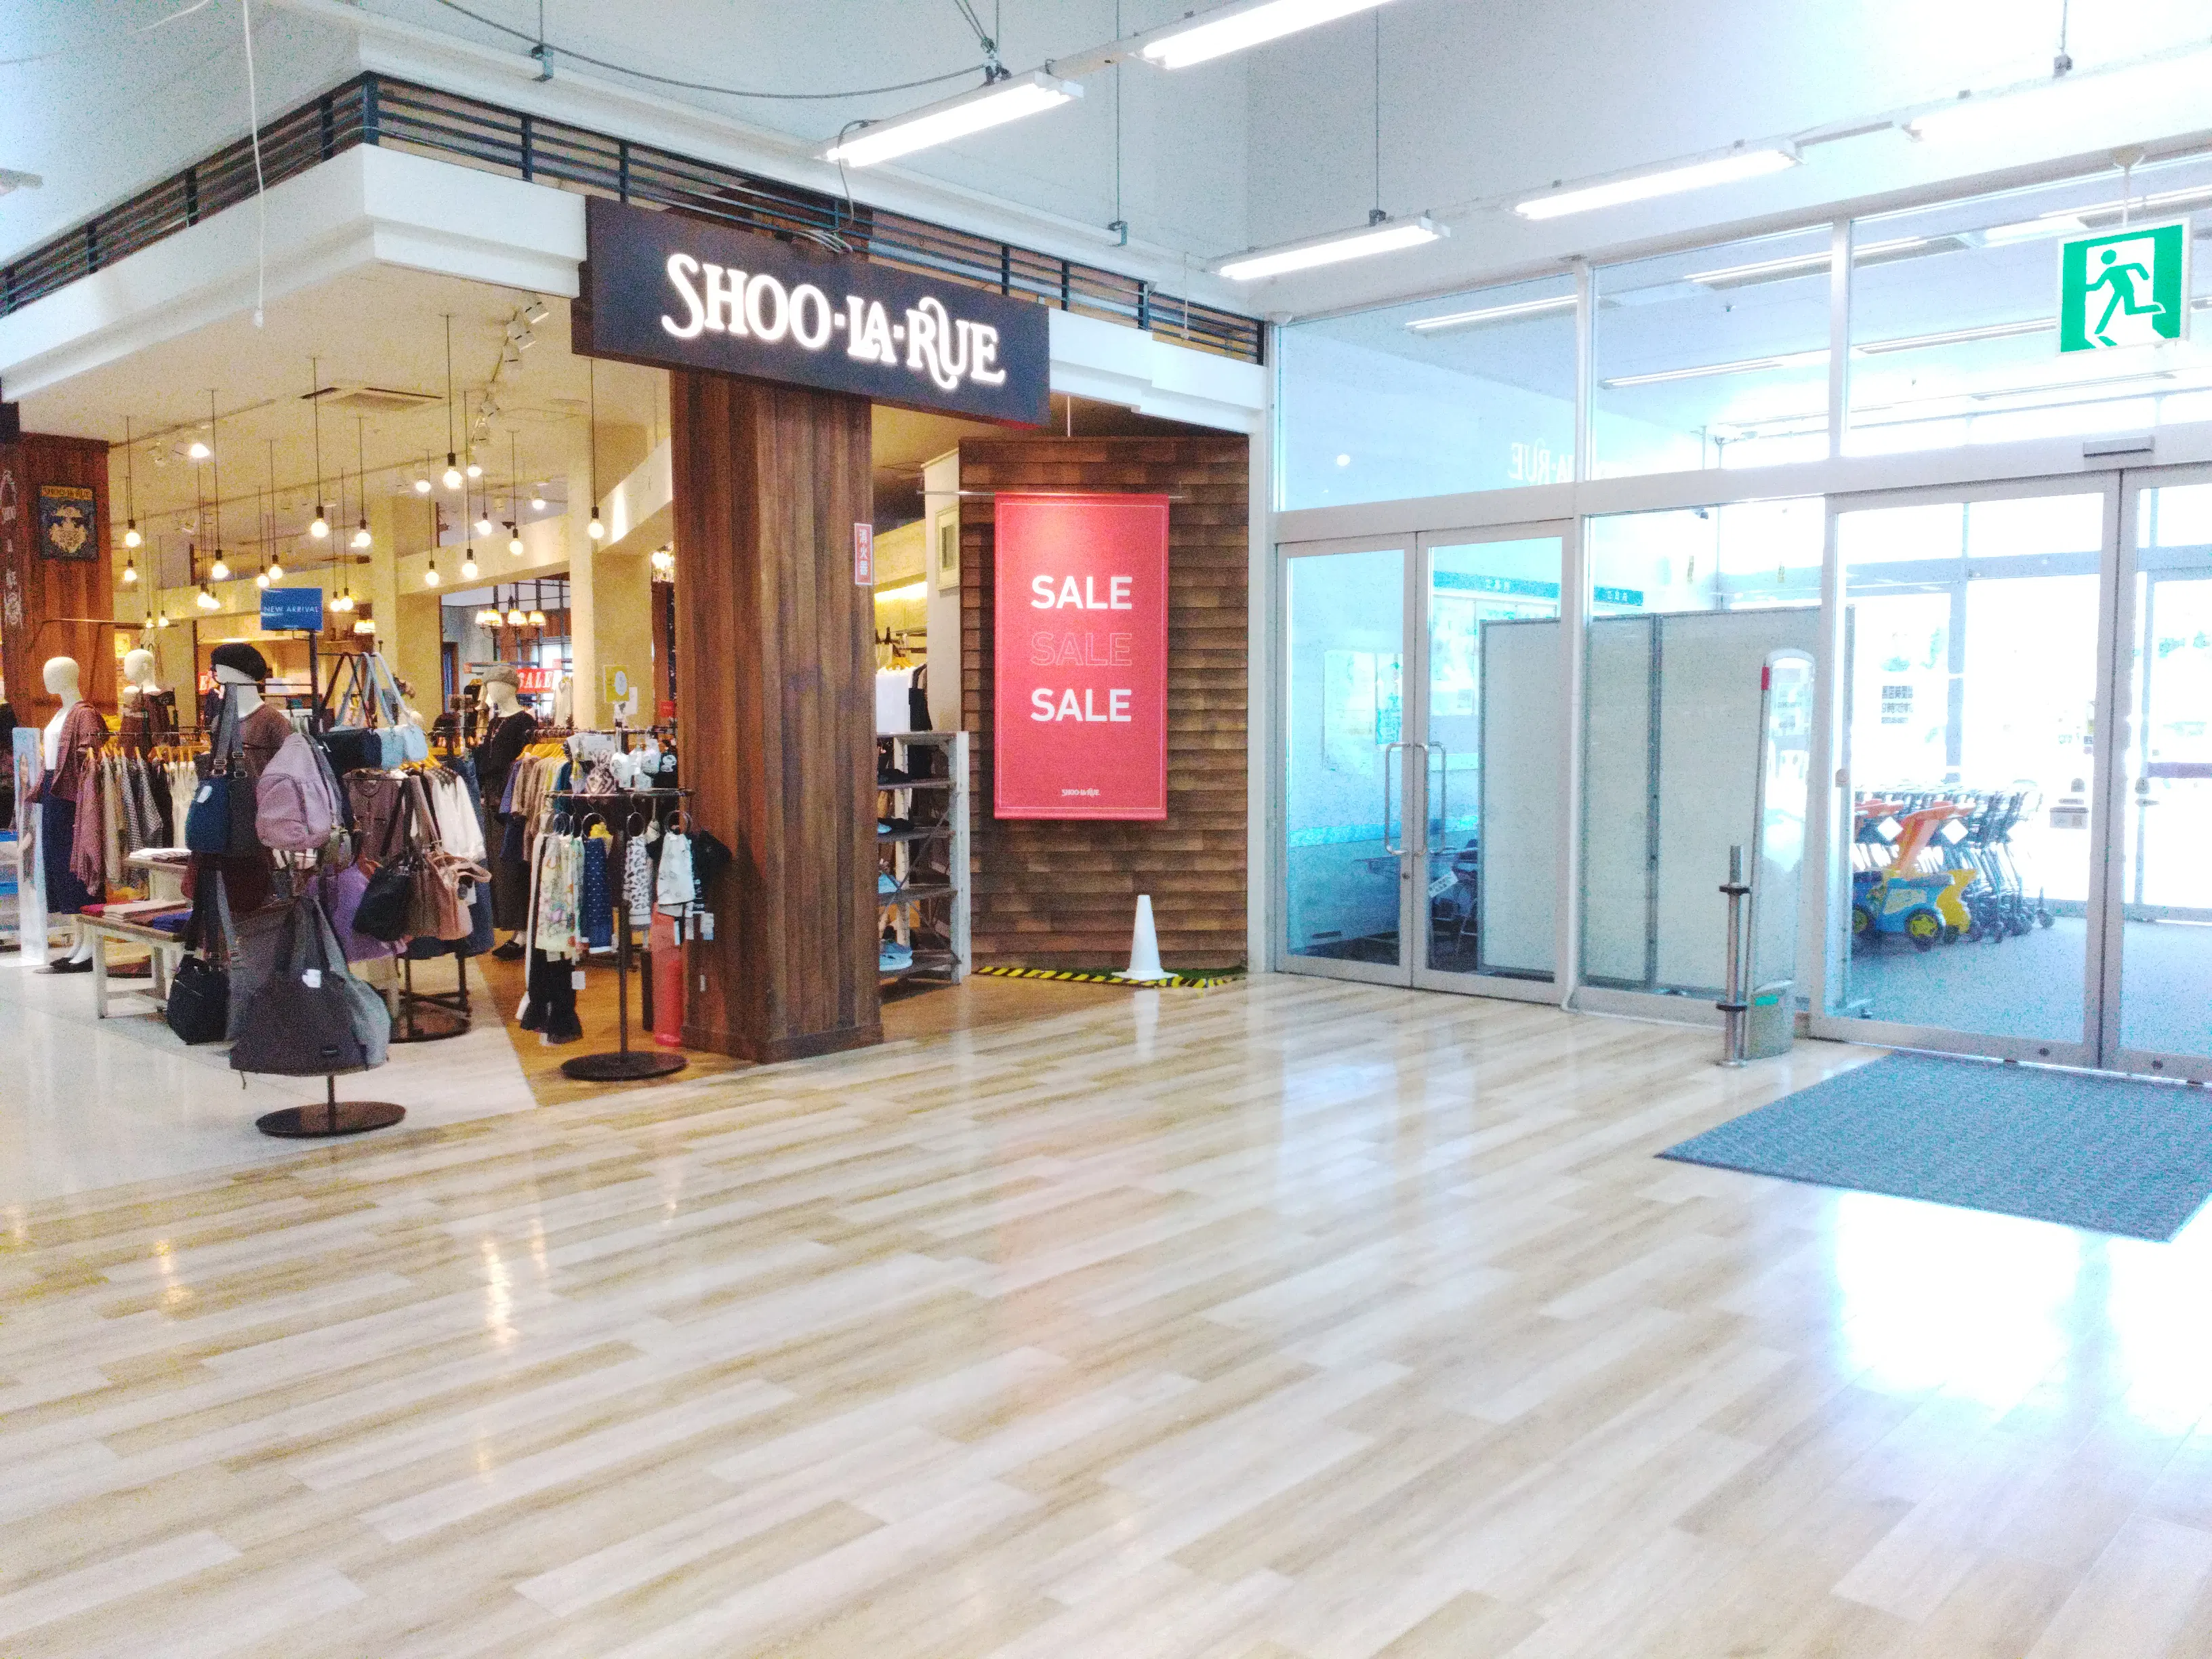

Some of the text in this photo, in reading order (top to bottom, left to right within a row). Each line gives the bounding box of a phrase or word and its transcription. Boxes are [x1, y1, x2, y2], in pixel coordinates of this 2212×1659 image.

[1031, 575, 1132, 609] SALE
[1029, 631, 1133, 667] SALE
[1030, 688, 1132, 722] SALE
